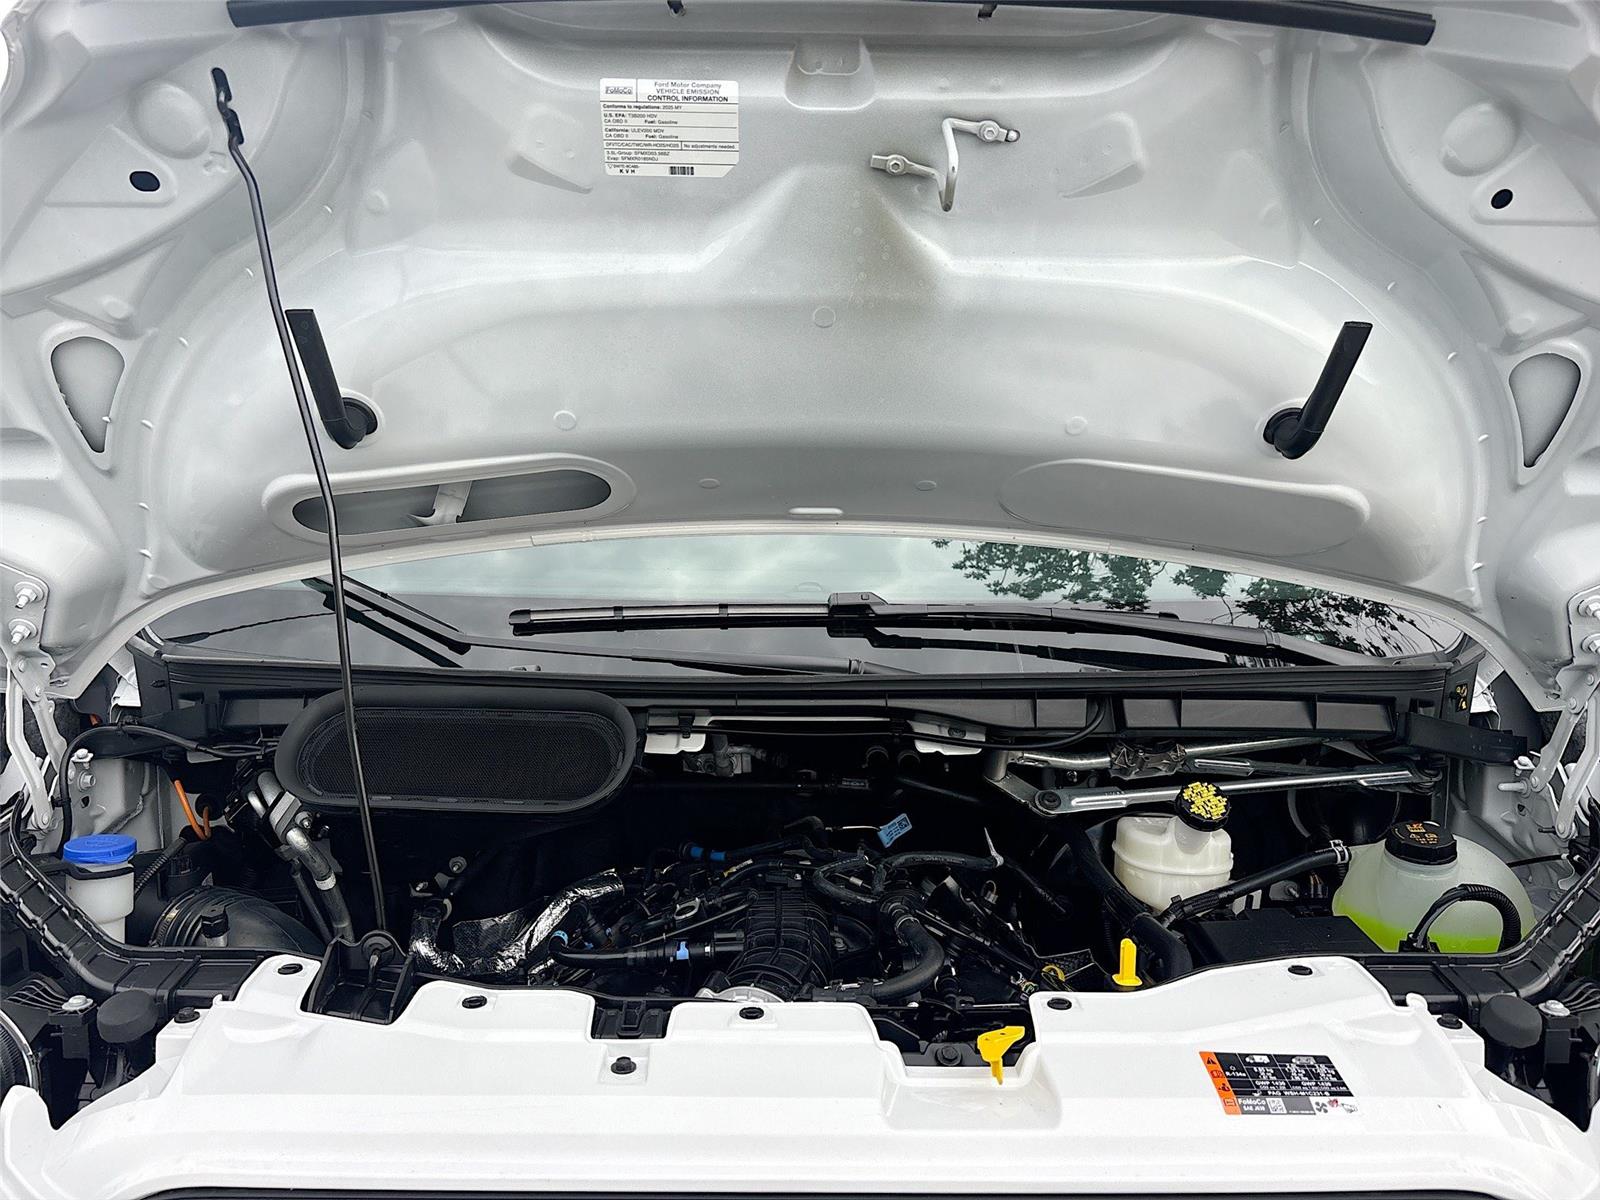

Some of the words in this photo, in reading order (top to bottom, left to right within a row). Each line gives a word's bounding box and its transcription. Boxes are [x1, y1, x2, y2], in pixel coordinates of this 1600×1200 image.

[691, 82, 722, 90] Company
[605, 86, 633, 95] FoMoCo
[681, 95, 729, 103] INFORMATION
